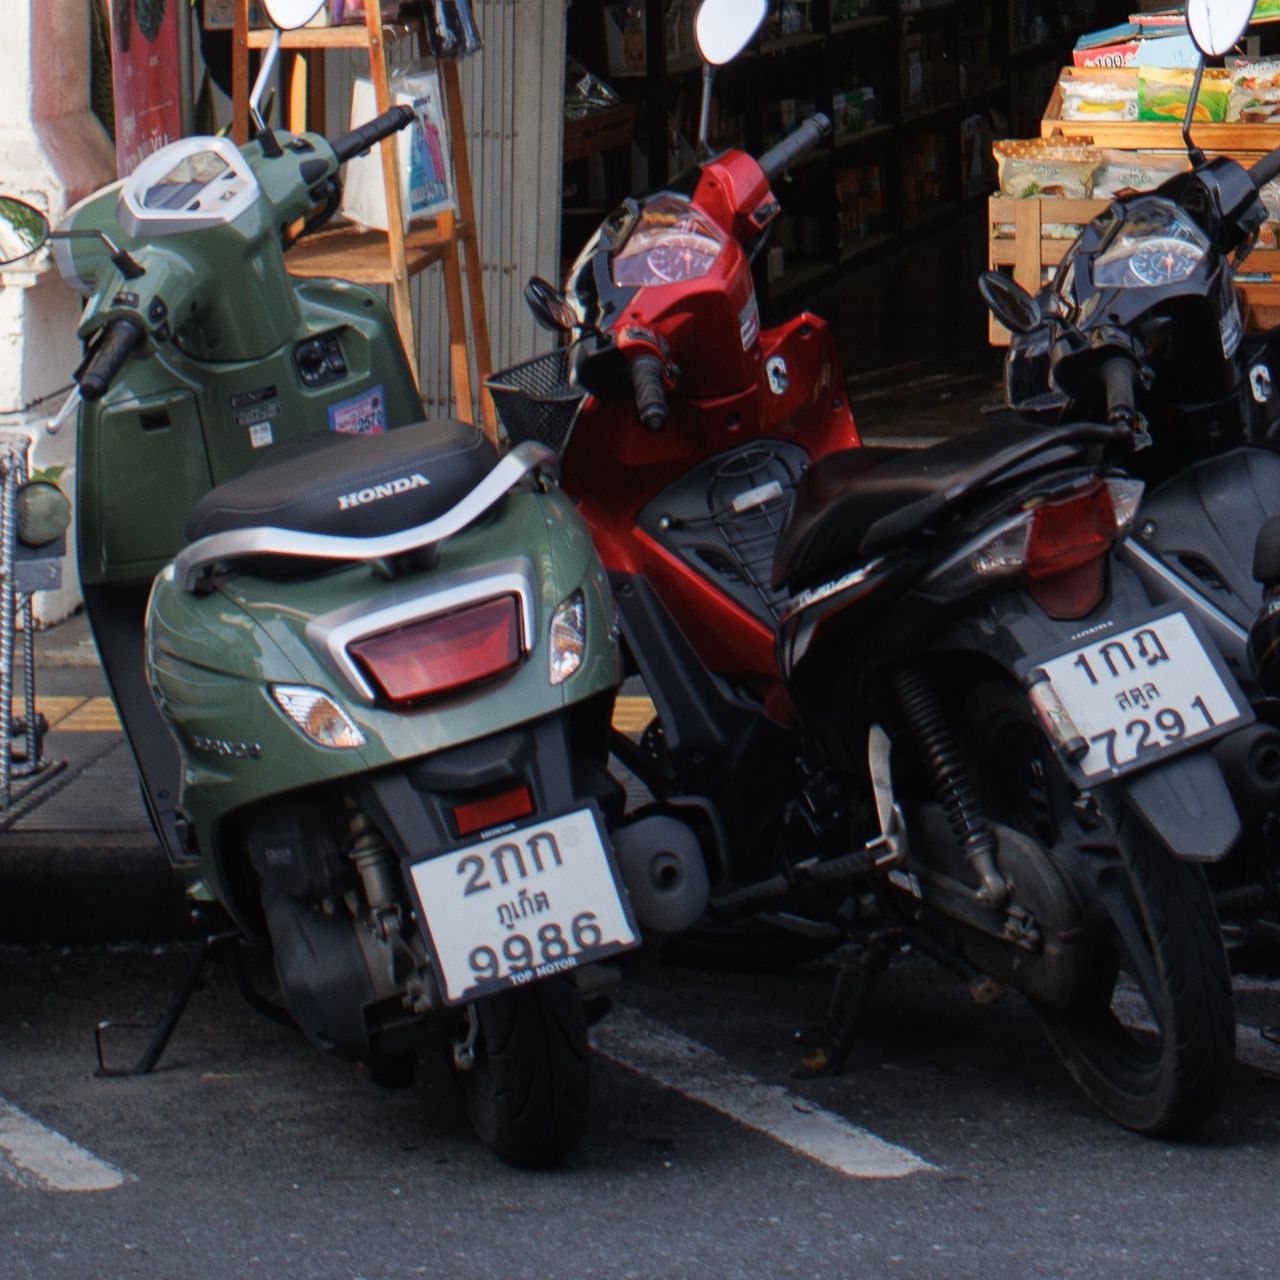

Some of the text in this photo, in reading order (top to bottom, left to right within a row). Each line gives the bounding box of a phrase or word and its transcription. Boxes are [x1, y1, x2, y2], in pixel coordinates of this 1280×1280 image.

[336, 472, 431, 511] HONDA
[1114, 681, 1161, 711] สตูล
[1090, 695, 1216, 769] 7291
[480, 822, 517, 840] HONDA
[456, 829, 563, 897] 2กก
[496, 887, 551, 930] ภูเก็ต
[468, 910, 603, 984] 9986
[510, 955, 578, 986] TOP MOTOR
